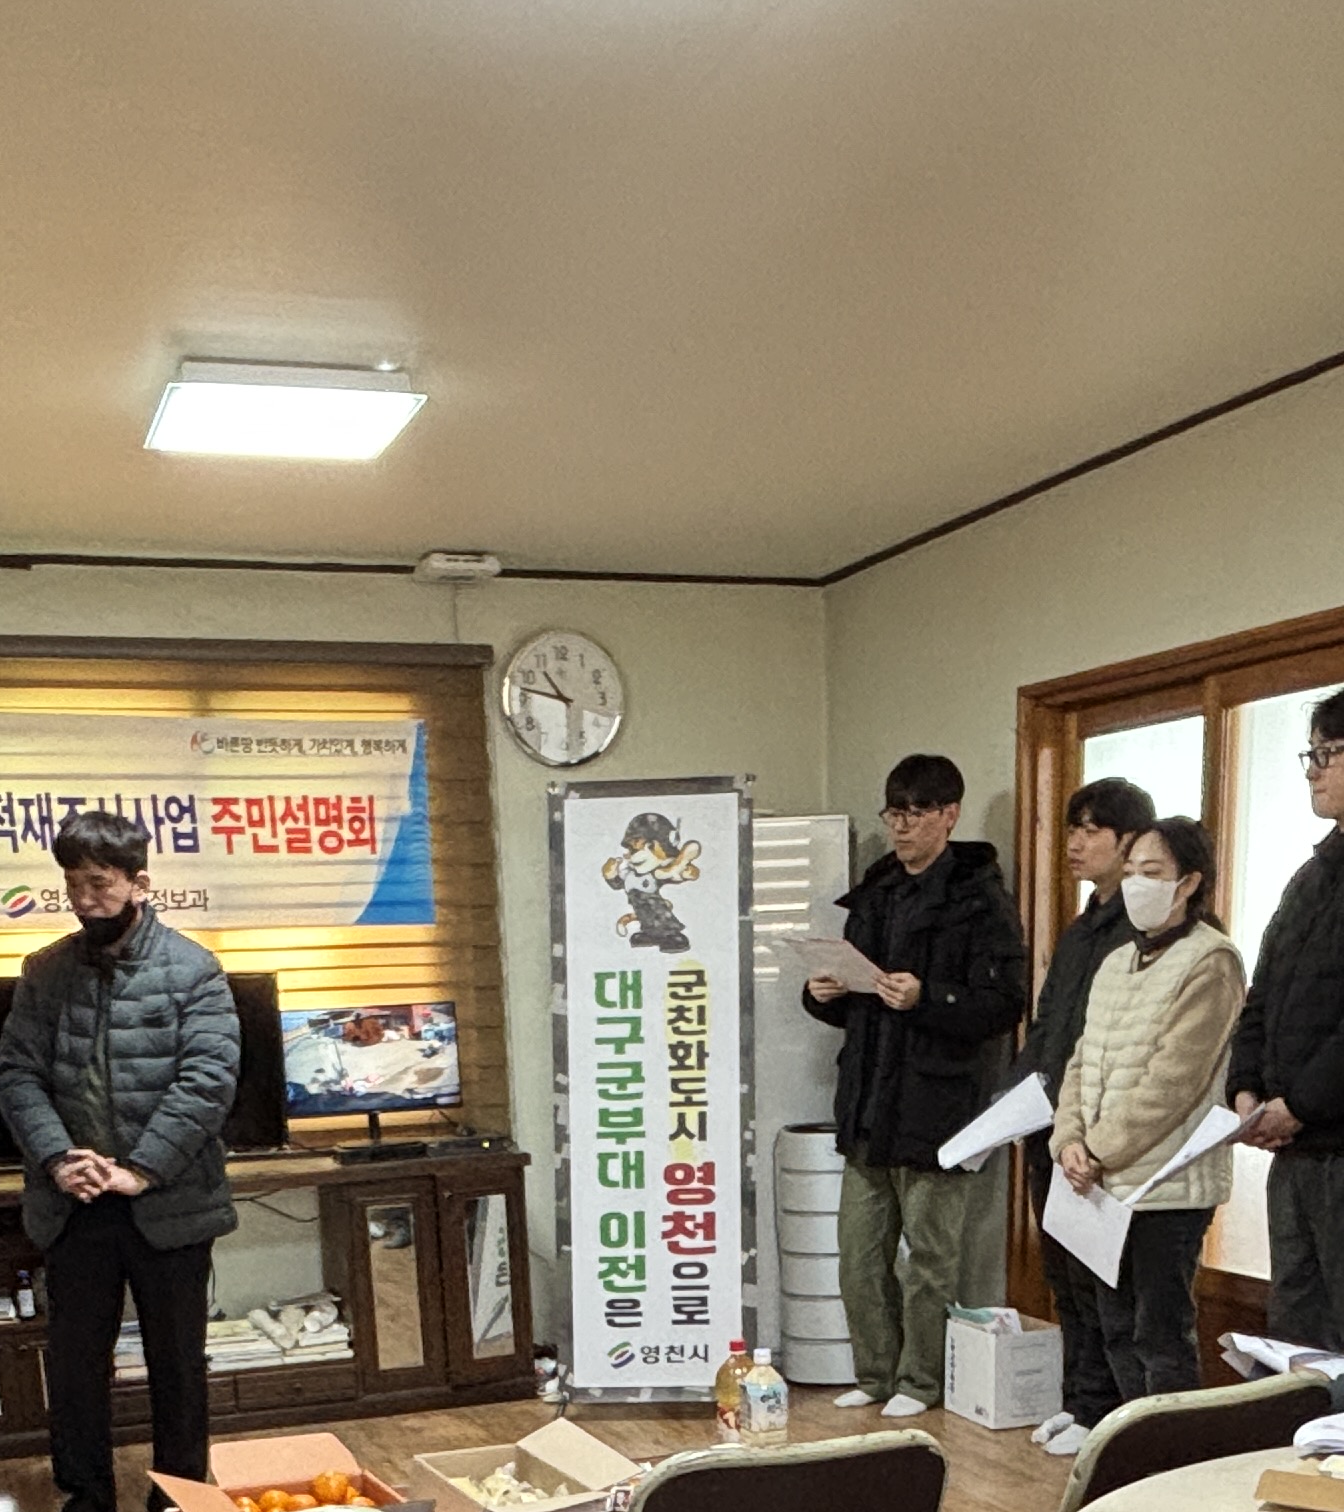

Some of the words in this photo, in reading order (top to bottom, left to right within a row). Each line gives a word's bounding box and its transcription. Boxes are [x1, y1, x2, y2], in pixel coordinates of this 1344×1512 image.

[524, 716, 536, 732] 8
[211, 794, 378, 856] 주민설명회
[150, 887, 209, 912] 정보과
[593, 969, 646, 1189] 대구군부대
[667, 969, 710, 1142] 군친화도시
[597, 1210, 647, 1328] 이전은
[660, 1161, 717, 1327] 영천으로
[640, 1343, 710, 1365] 영천시
